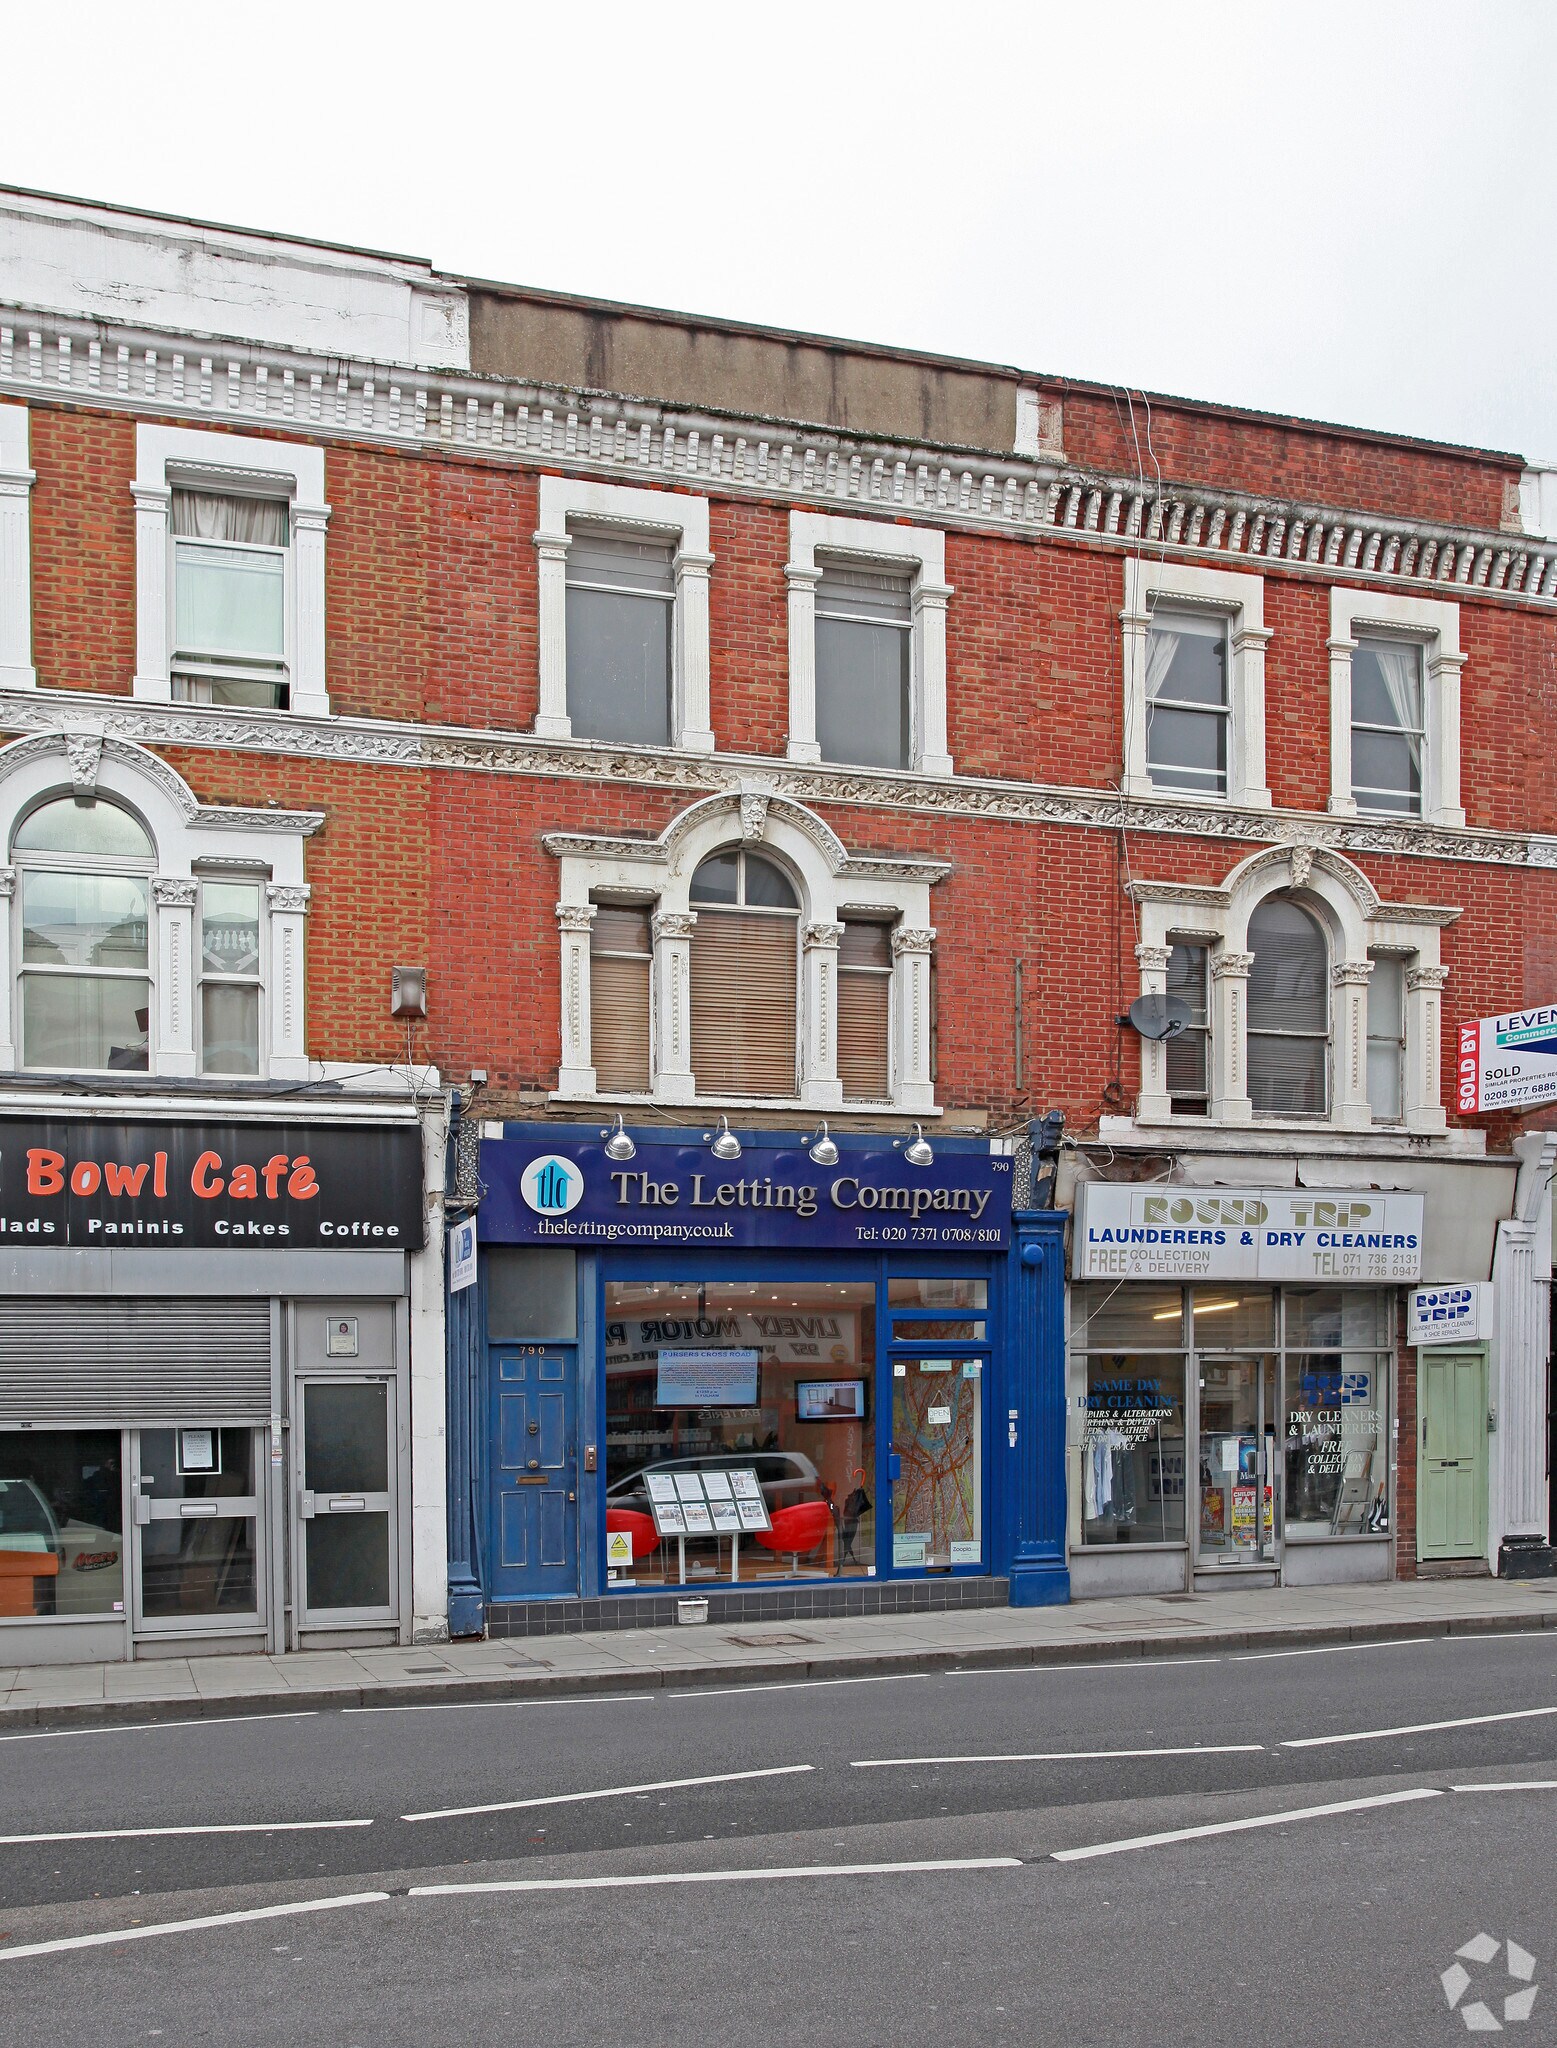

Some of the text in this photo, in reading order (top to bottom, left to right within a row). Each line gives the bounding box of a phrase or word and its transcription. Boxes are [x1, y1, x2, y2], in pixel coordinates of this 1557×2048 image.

[1460, 1028, 1477, 1110] SOLD BY
[1485, 1065, 1521, 1081] SOLD
[1509, 1074, 1546, 1084] PROPERTIES
[1484, 1082, 1556, 1101] 0208 977 6886
[991, 1161, 1009, 1173] 790
[26, 1148, 320, 1200] Bowl Café
[540, 1165, 567, 1209] tlc
[610, 1171, 993, 1220] The Letting Company
[1143, 1197, 1372, 1228] ROUND TRIP
[88, 1218, 184, 1235] Paninis
[215, 1220, 290, 1236] Cakes
[319, 1221, 400, 1237] Coffee
[855, 1226, 879, 1241] Tel:
[882, 1227, 906, 1241] 020
[910, 1227, 938, 1242] 7371
[1088, 1228, 1418, 1249] LAUNDERERS & DRY CLEANERS
[1089, 1249, 1127, 1273] FREE
[1130, 1250, 1211, 1262] COLLECTION
[1343, 1253, 1418, 1265] 071 736 2131
[1134, 1262, 1210, 1274] & DELIVERY
[1313, 1252, 1340, 1276] TEL
[1343, 1265, 1418, 1277] 071 736 0947
[1417, 1290, 1471, 1308] ROUND
[1417, 1305, 1469, 1322] TRIP
[1451, 1320, 1474, 1328] CLEANING
[519, 1346, 545, 1355] 790
[1093, 1378, 1162, 1392] SAME DAY
[1077, 1395, 1178, 1408] DRY CLEANING
[928, 1409, 950, 1417] OPEN
[1112, 1409, 1119, 1418] &
[1120, 1408, 1173, 1418] ALTERATIONS
[1290, 1410, 1383, 1422] DRY CLEANERS
[1114, 1426, 1149, 1435] LEATHER
[1289, 1423, 1383, 1436] & LAUNDERERS
[1320, 1440, 1353, 1453] FREE
[1307, 1465, 1316, 1474] &
